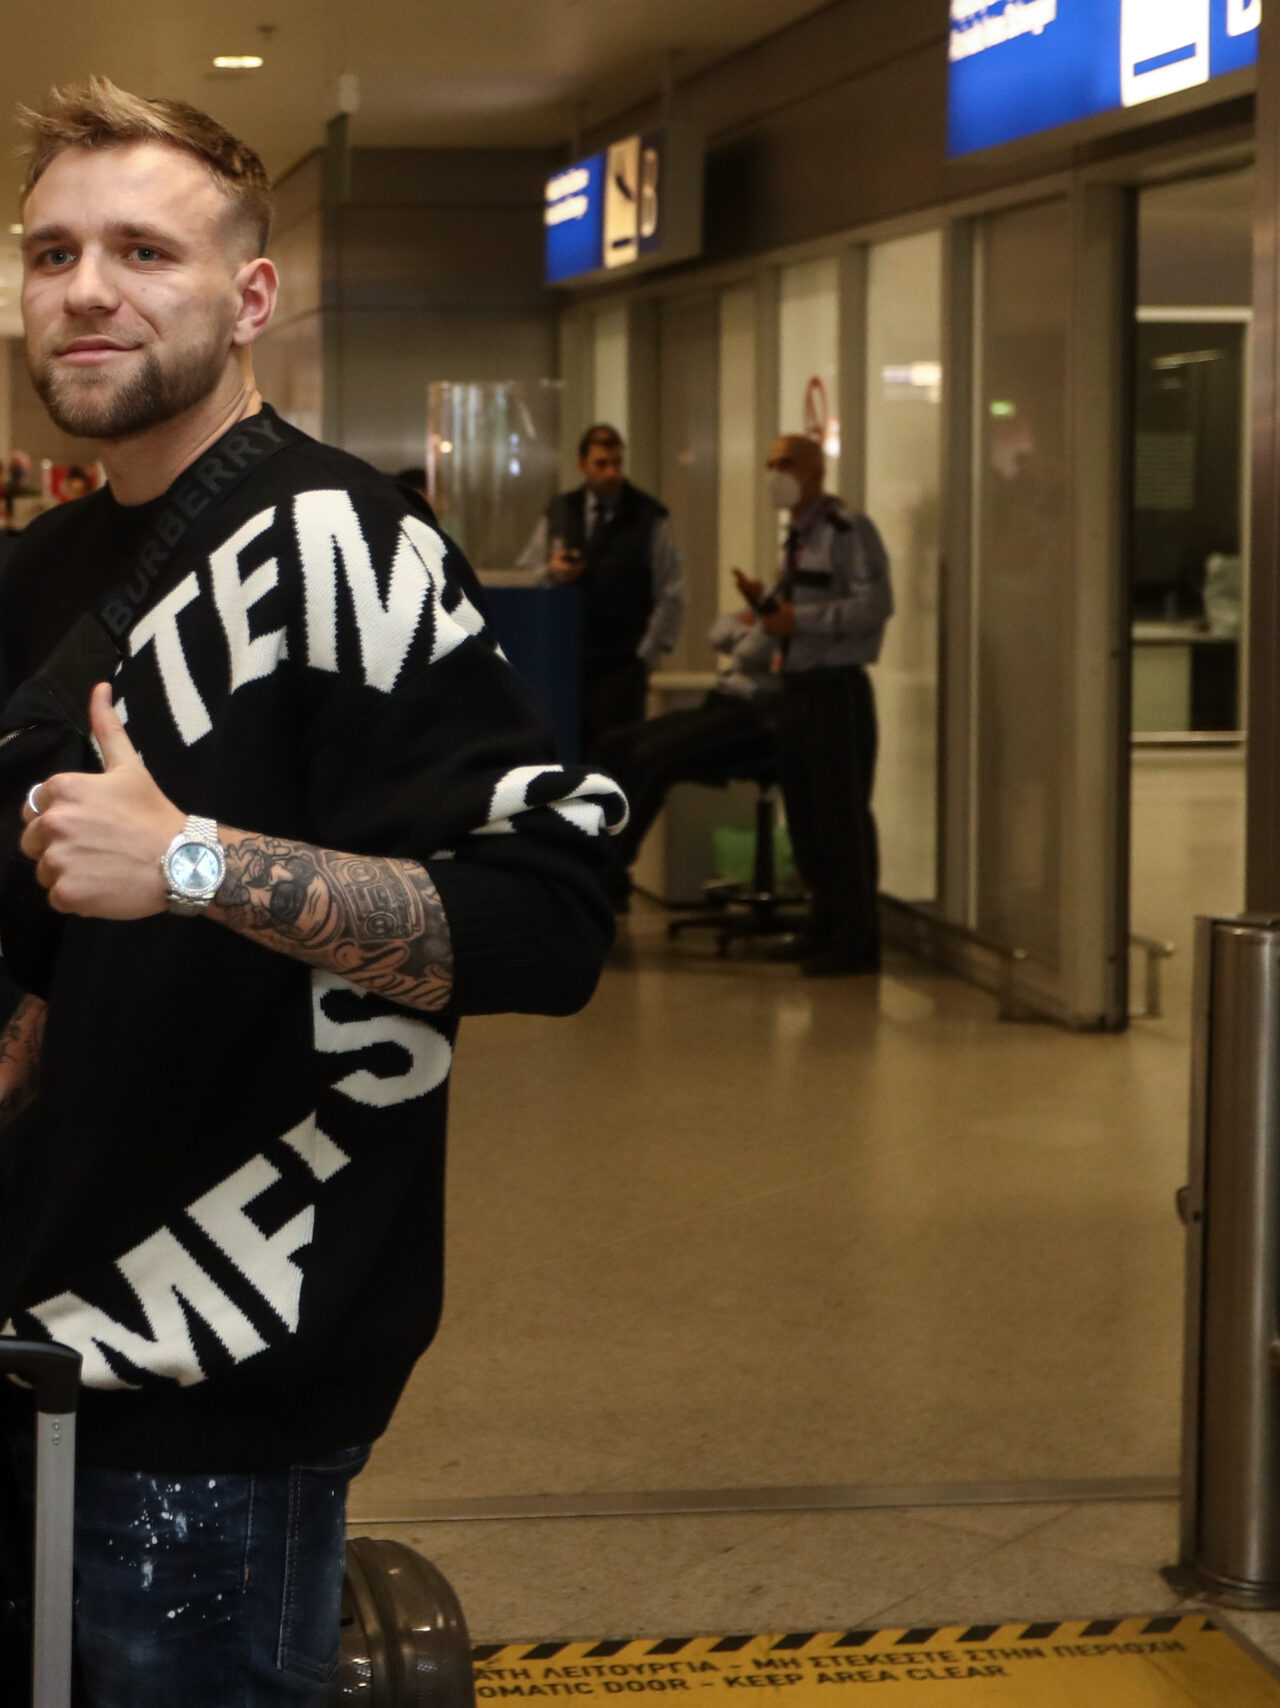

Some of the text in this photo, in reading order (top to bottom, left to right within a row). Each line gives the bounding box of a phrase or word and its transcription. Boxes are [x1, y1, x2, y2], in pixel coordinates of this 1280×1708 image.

[100, 418, 283, 637] BURBERRY
[604, 1678, 690, 1694] DOOR
[725, 1672, 804, 1690] KEEP
[817, 1668, 901, 1684] AREA
[907, 1665, 1008, 1681] CLEAR
